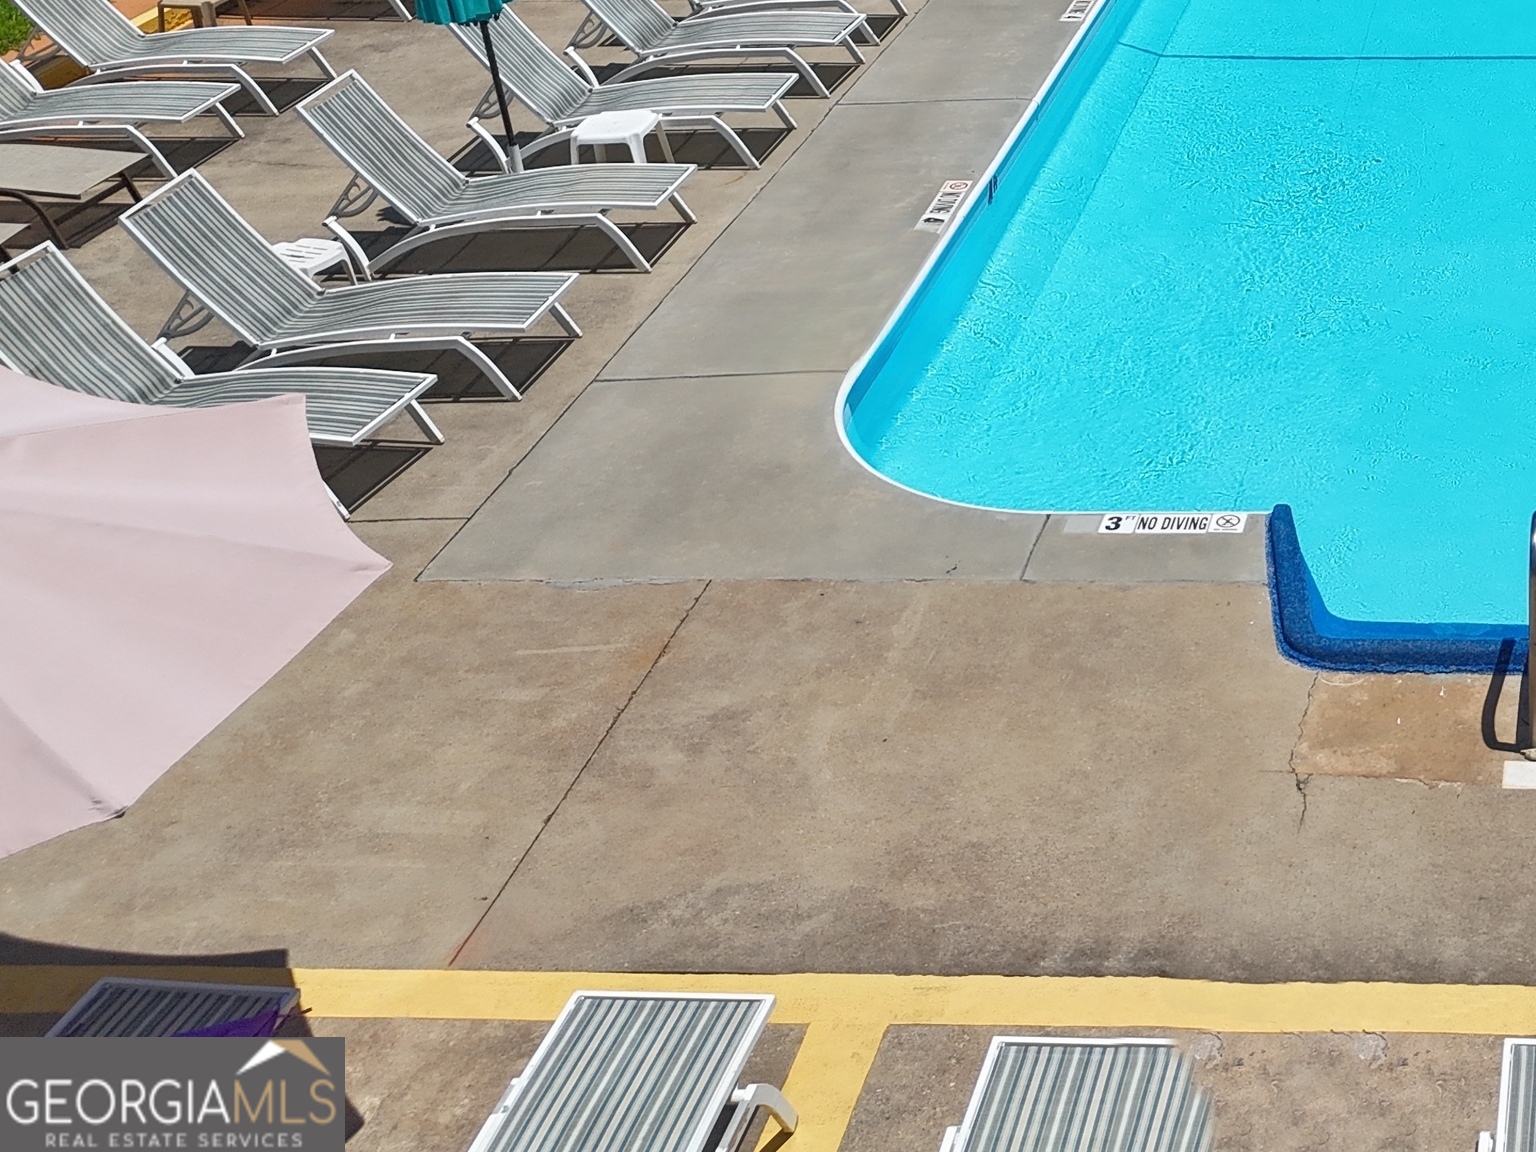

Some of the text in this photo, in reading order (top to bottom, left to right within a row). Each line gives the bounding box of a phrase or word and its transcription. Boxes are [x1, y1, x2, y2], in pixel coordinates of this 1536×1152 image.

[1105, 516, 1123, 530] 3
[1137, 516, 1208, 530] NO DIVING
